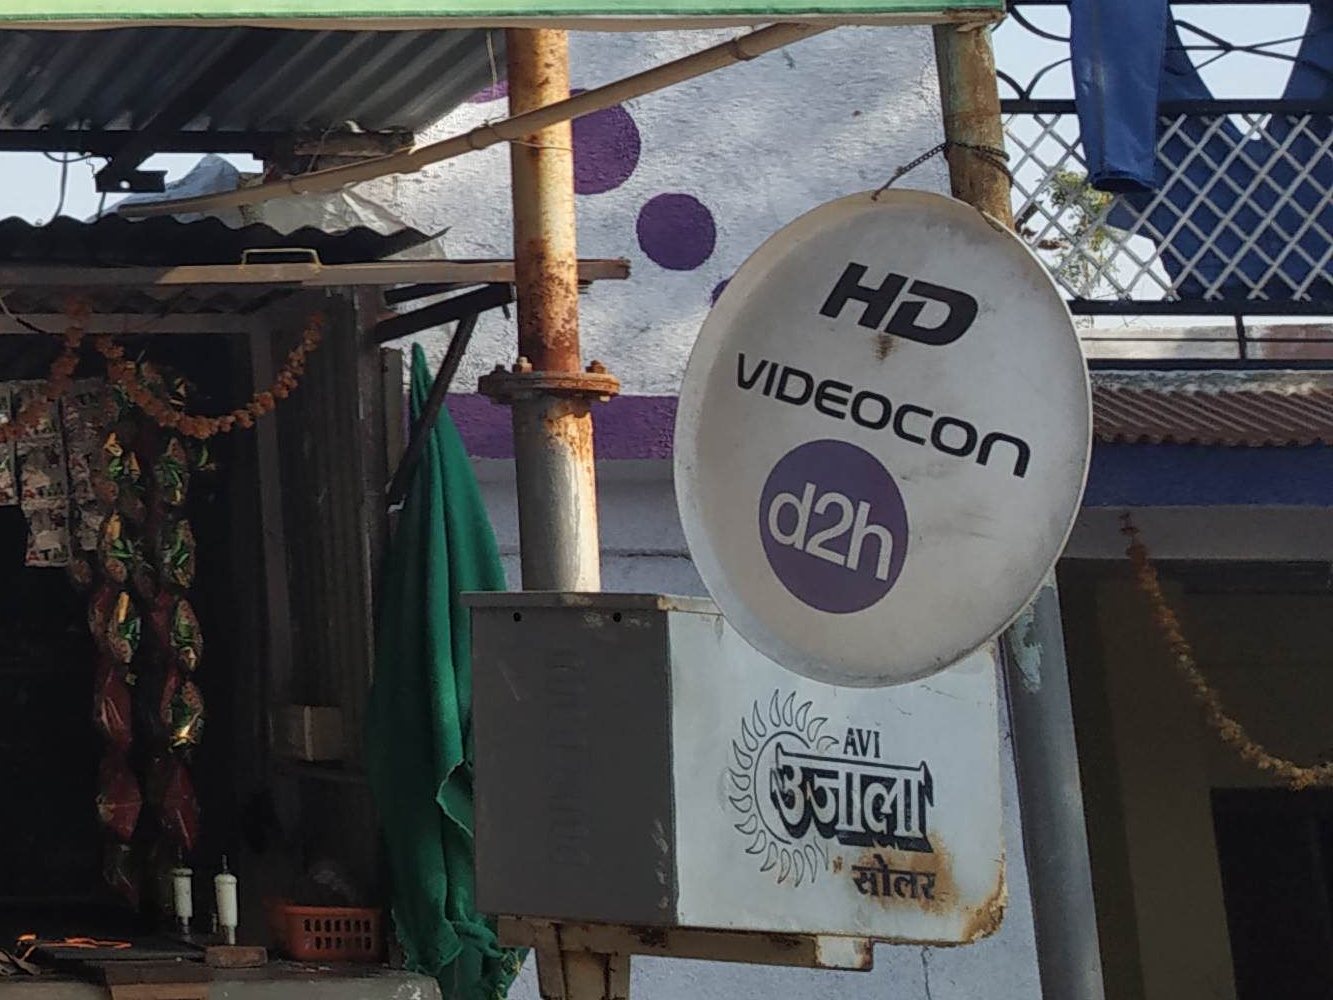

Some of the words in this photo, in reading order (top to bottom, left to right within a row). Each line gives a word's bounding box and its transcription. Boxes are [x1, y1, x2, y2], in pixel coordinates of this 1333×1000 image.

[819, 262, 979, 346] HD
[736, 353, 1031, 479] VIDEOCON
[767, 482, 894, 581] d2h
[843, 727, 881, 759] AVI
[769, 743, 934, 853] उजाला
[852, 853, 936, 900] सोलर
